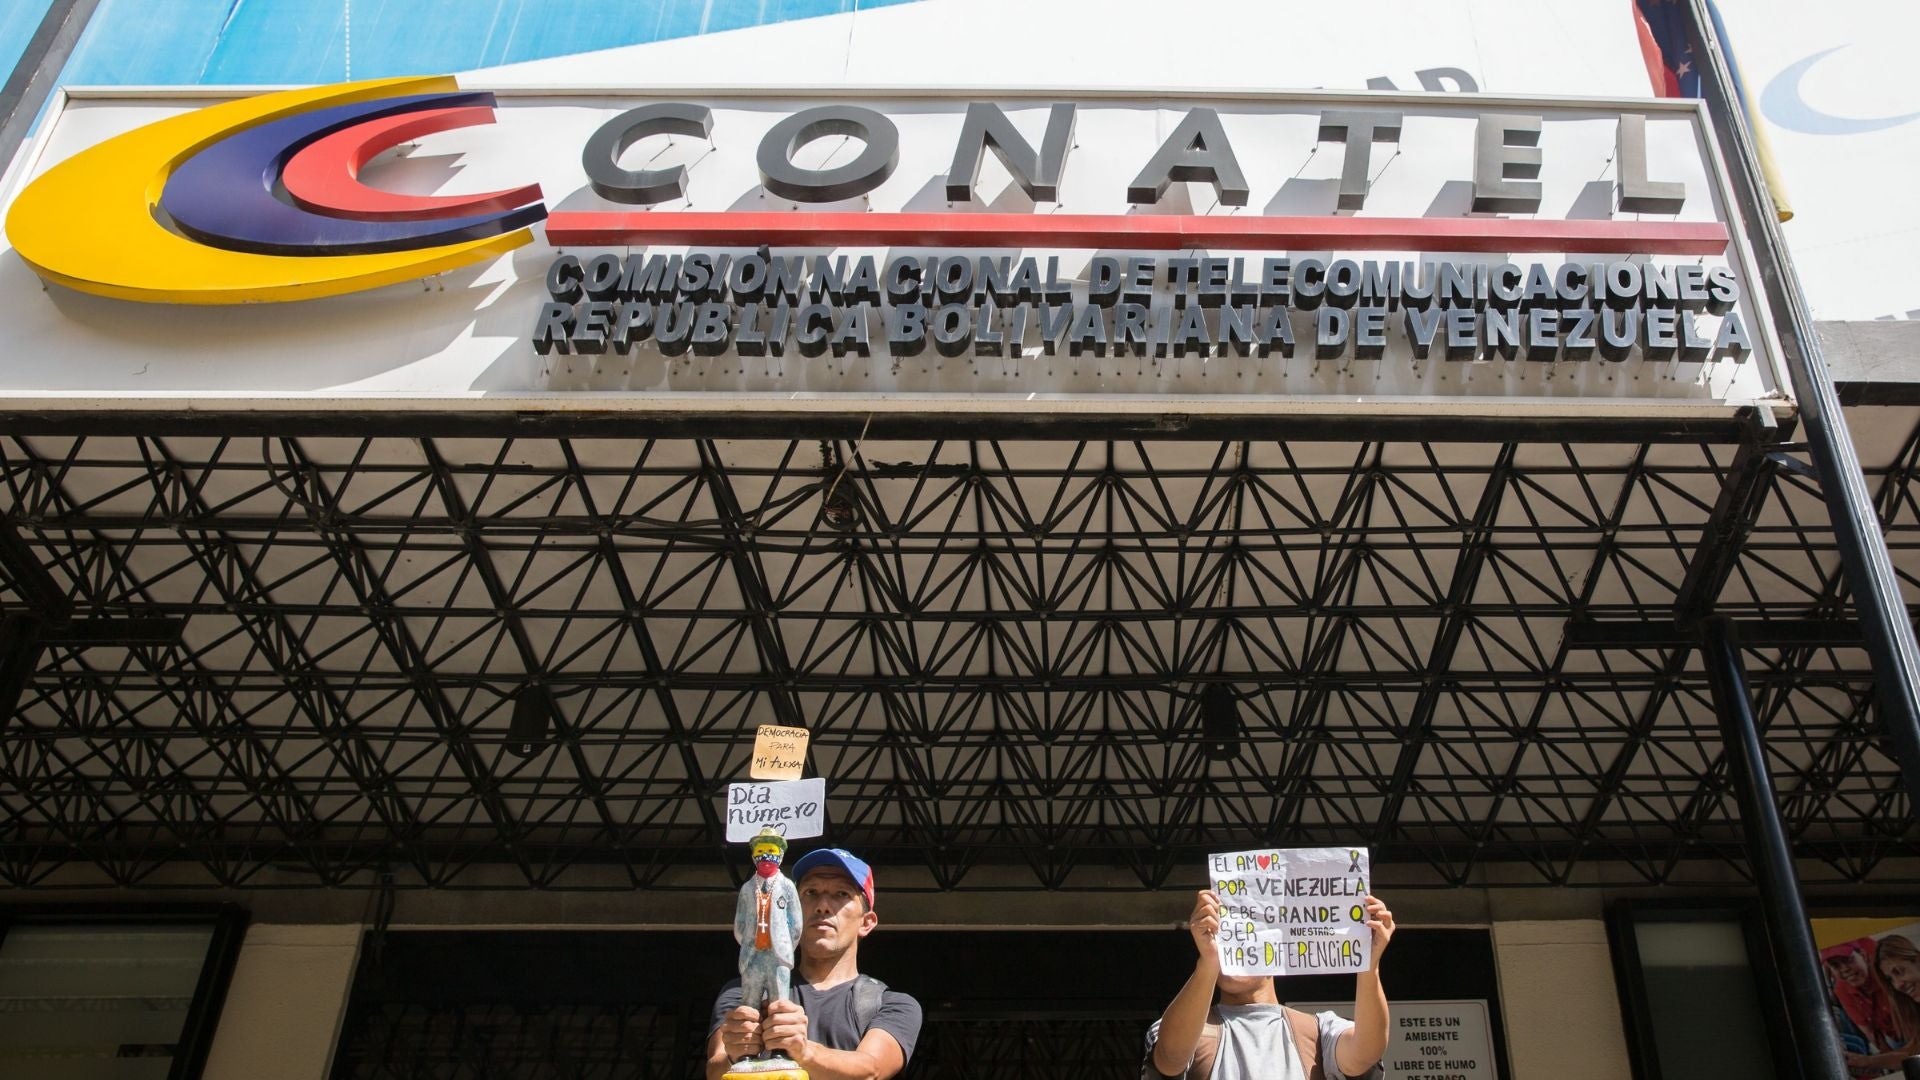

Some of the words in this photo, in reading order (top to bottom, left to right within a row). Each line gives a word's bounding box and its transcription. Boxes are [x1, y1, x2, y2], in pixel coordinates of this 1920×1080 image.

[582, 102, 1686, 214] CONATEL
[546, 245, 807, 307] COMISIÓN
[809, 255, 1072, 307] NACIONAL
[1088, 257, 1156, 308] DE
[1168, 257, 1741, 316] TELECOMUNICACIONES
[889, 303, 1295, 358] BOLIVARIANA
[1315, 306, 1386, 360] DE
[1404, 307, 1752, 364] VENEZUELA
[729, 802, 818, 825] número
[1214, 856, 1233, 873] EL
[1217, 879, 1248, 896] POR
[1255, 877, 1368, 897] VENEZUELA
[1218, 905, 1257, 920] DEBE
[1263, 905, 1341, 924] GRANDE
[1220, 920, 1258, 943] SER
[1223, 942, 1260, 967] MÁS
[1400, 1017, 1426, 1028] ESTE
[1429, 1017, 1442, 1027] ES
[1445, 1017, 1461, 1027] UN
[1404, 1031, 1460, 1042] AMBIENTE
[1419, 1045, 1448, 1057] 100%
[1393, 1060, 1425, 1071] LIBRE
[1427, 1060, 1442, 1070] DE
[1444, 1059, 1477, 1070] HUMO
